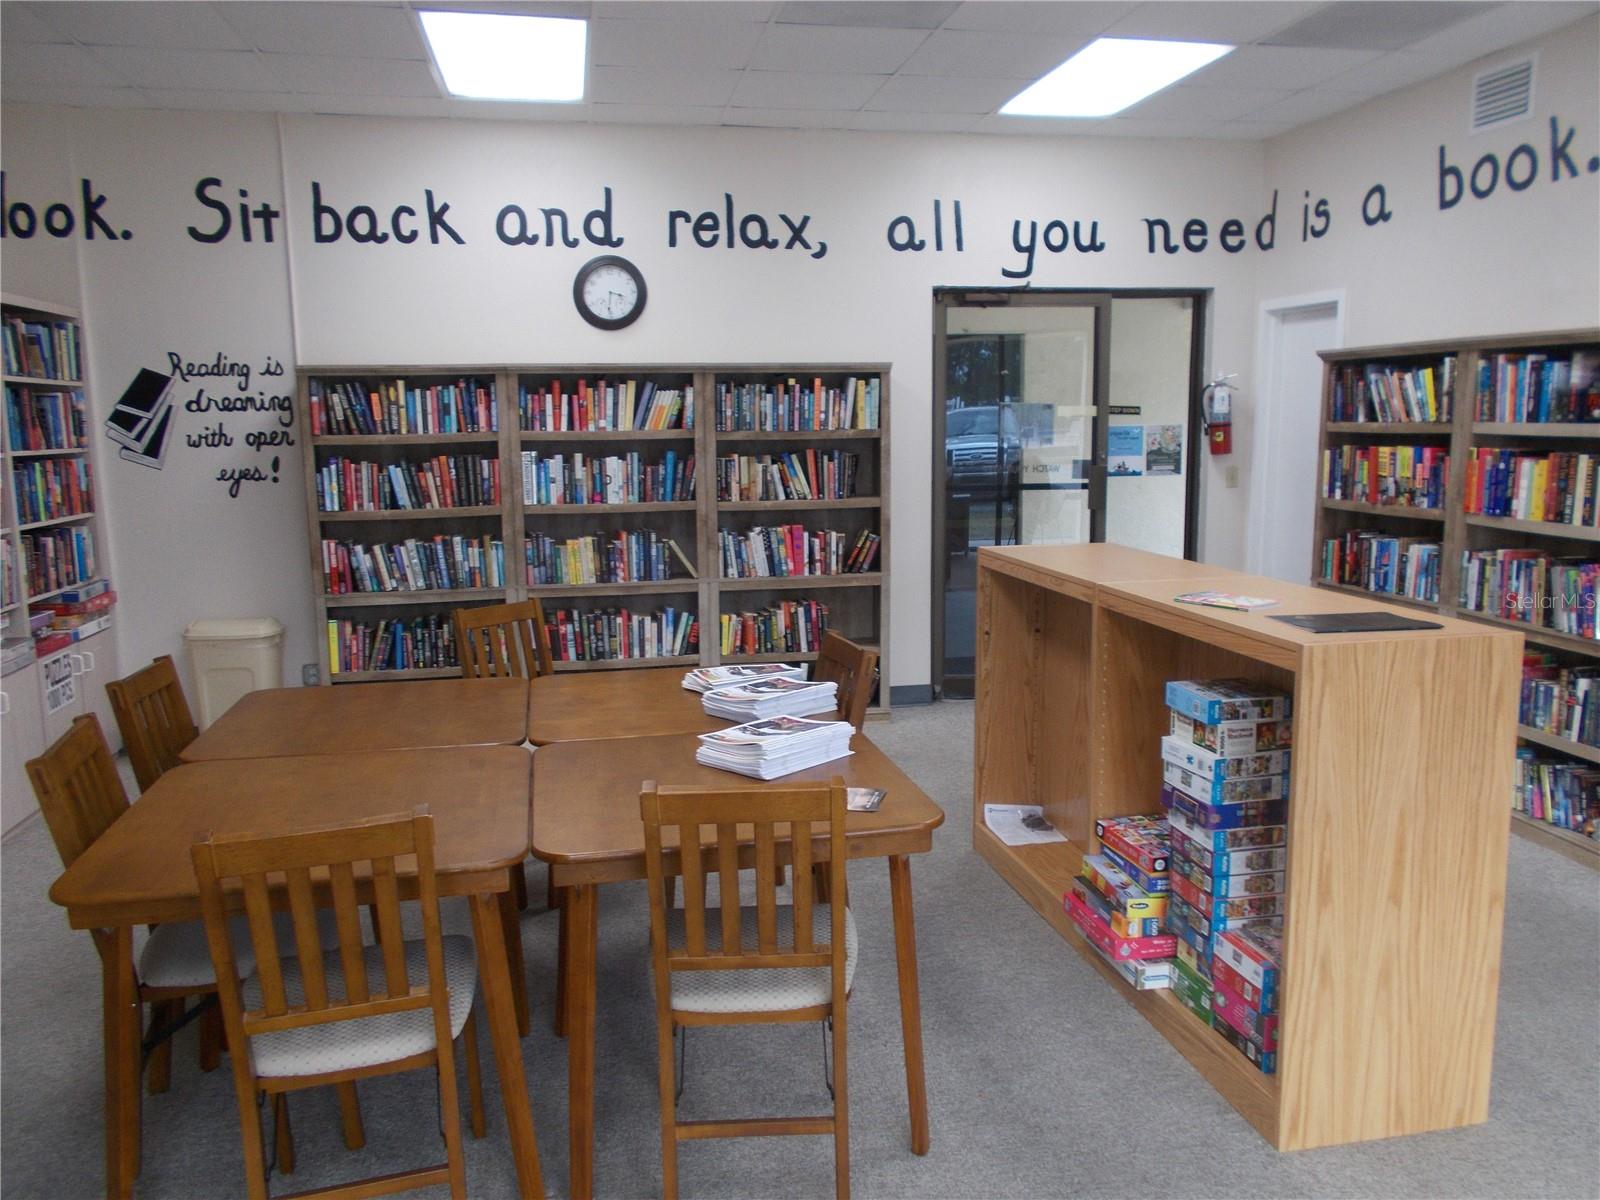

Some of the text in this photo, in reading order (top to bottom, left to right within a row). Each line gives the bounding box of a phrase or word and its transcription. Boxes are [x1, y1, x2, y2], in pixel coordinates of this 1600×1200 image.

[187, 177, 280, 243] Sit
[311, 181, 466, 244] back
[496, 187, 624, 248] and
[668, 193, 828, 259] relax,
[887, 199, 964, 252] all
[1001, 219, 1106, 278] you
[1141, 189, 1278, 254] need
[1302, 190, 1331, 242] is
[1362, 184, 1392, 226] a
[1438, 115, 1600, 210] book.
[167, 351, 284, 391] Reading is
[185, 388, 294, 428] dreaming
[186, 422, 295, 452] with open
[216, 456, 280, 498] eyes!
